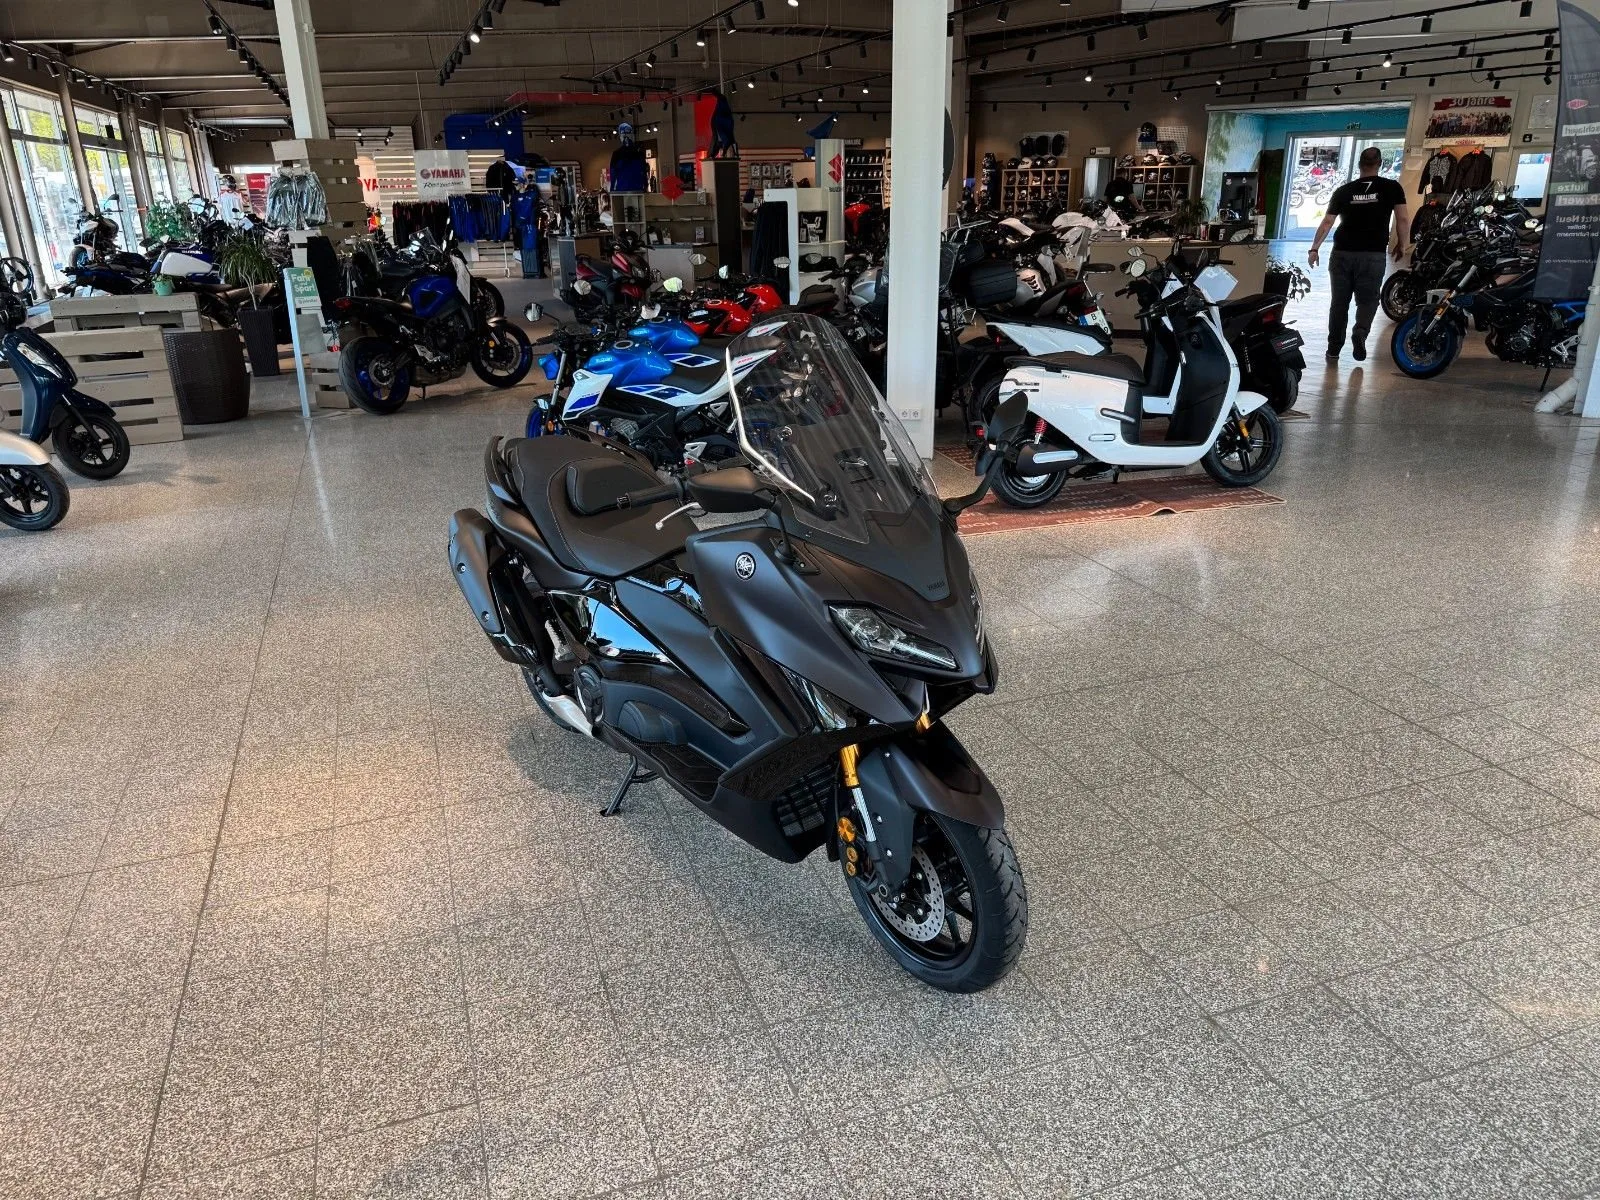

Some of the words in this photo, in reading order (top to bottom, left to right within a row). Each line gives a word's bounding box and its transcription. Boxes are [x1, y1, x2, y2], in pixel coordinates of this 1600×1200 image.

[1465, 96, 1495, 109] Jahre
[430, 168, 466, 179] YAMAHA
[291, 273, 312, 282] Fahr
